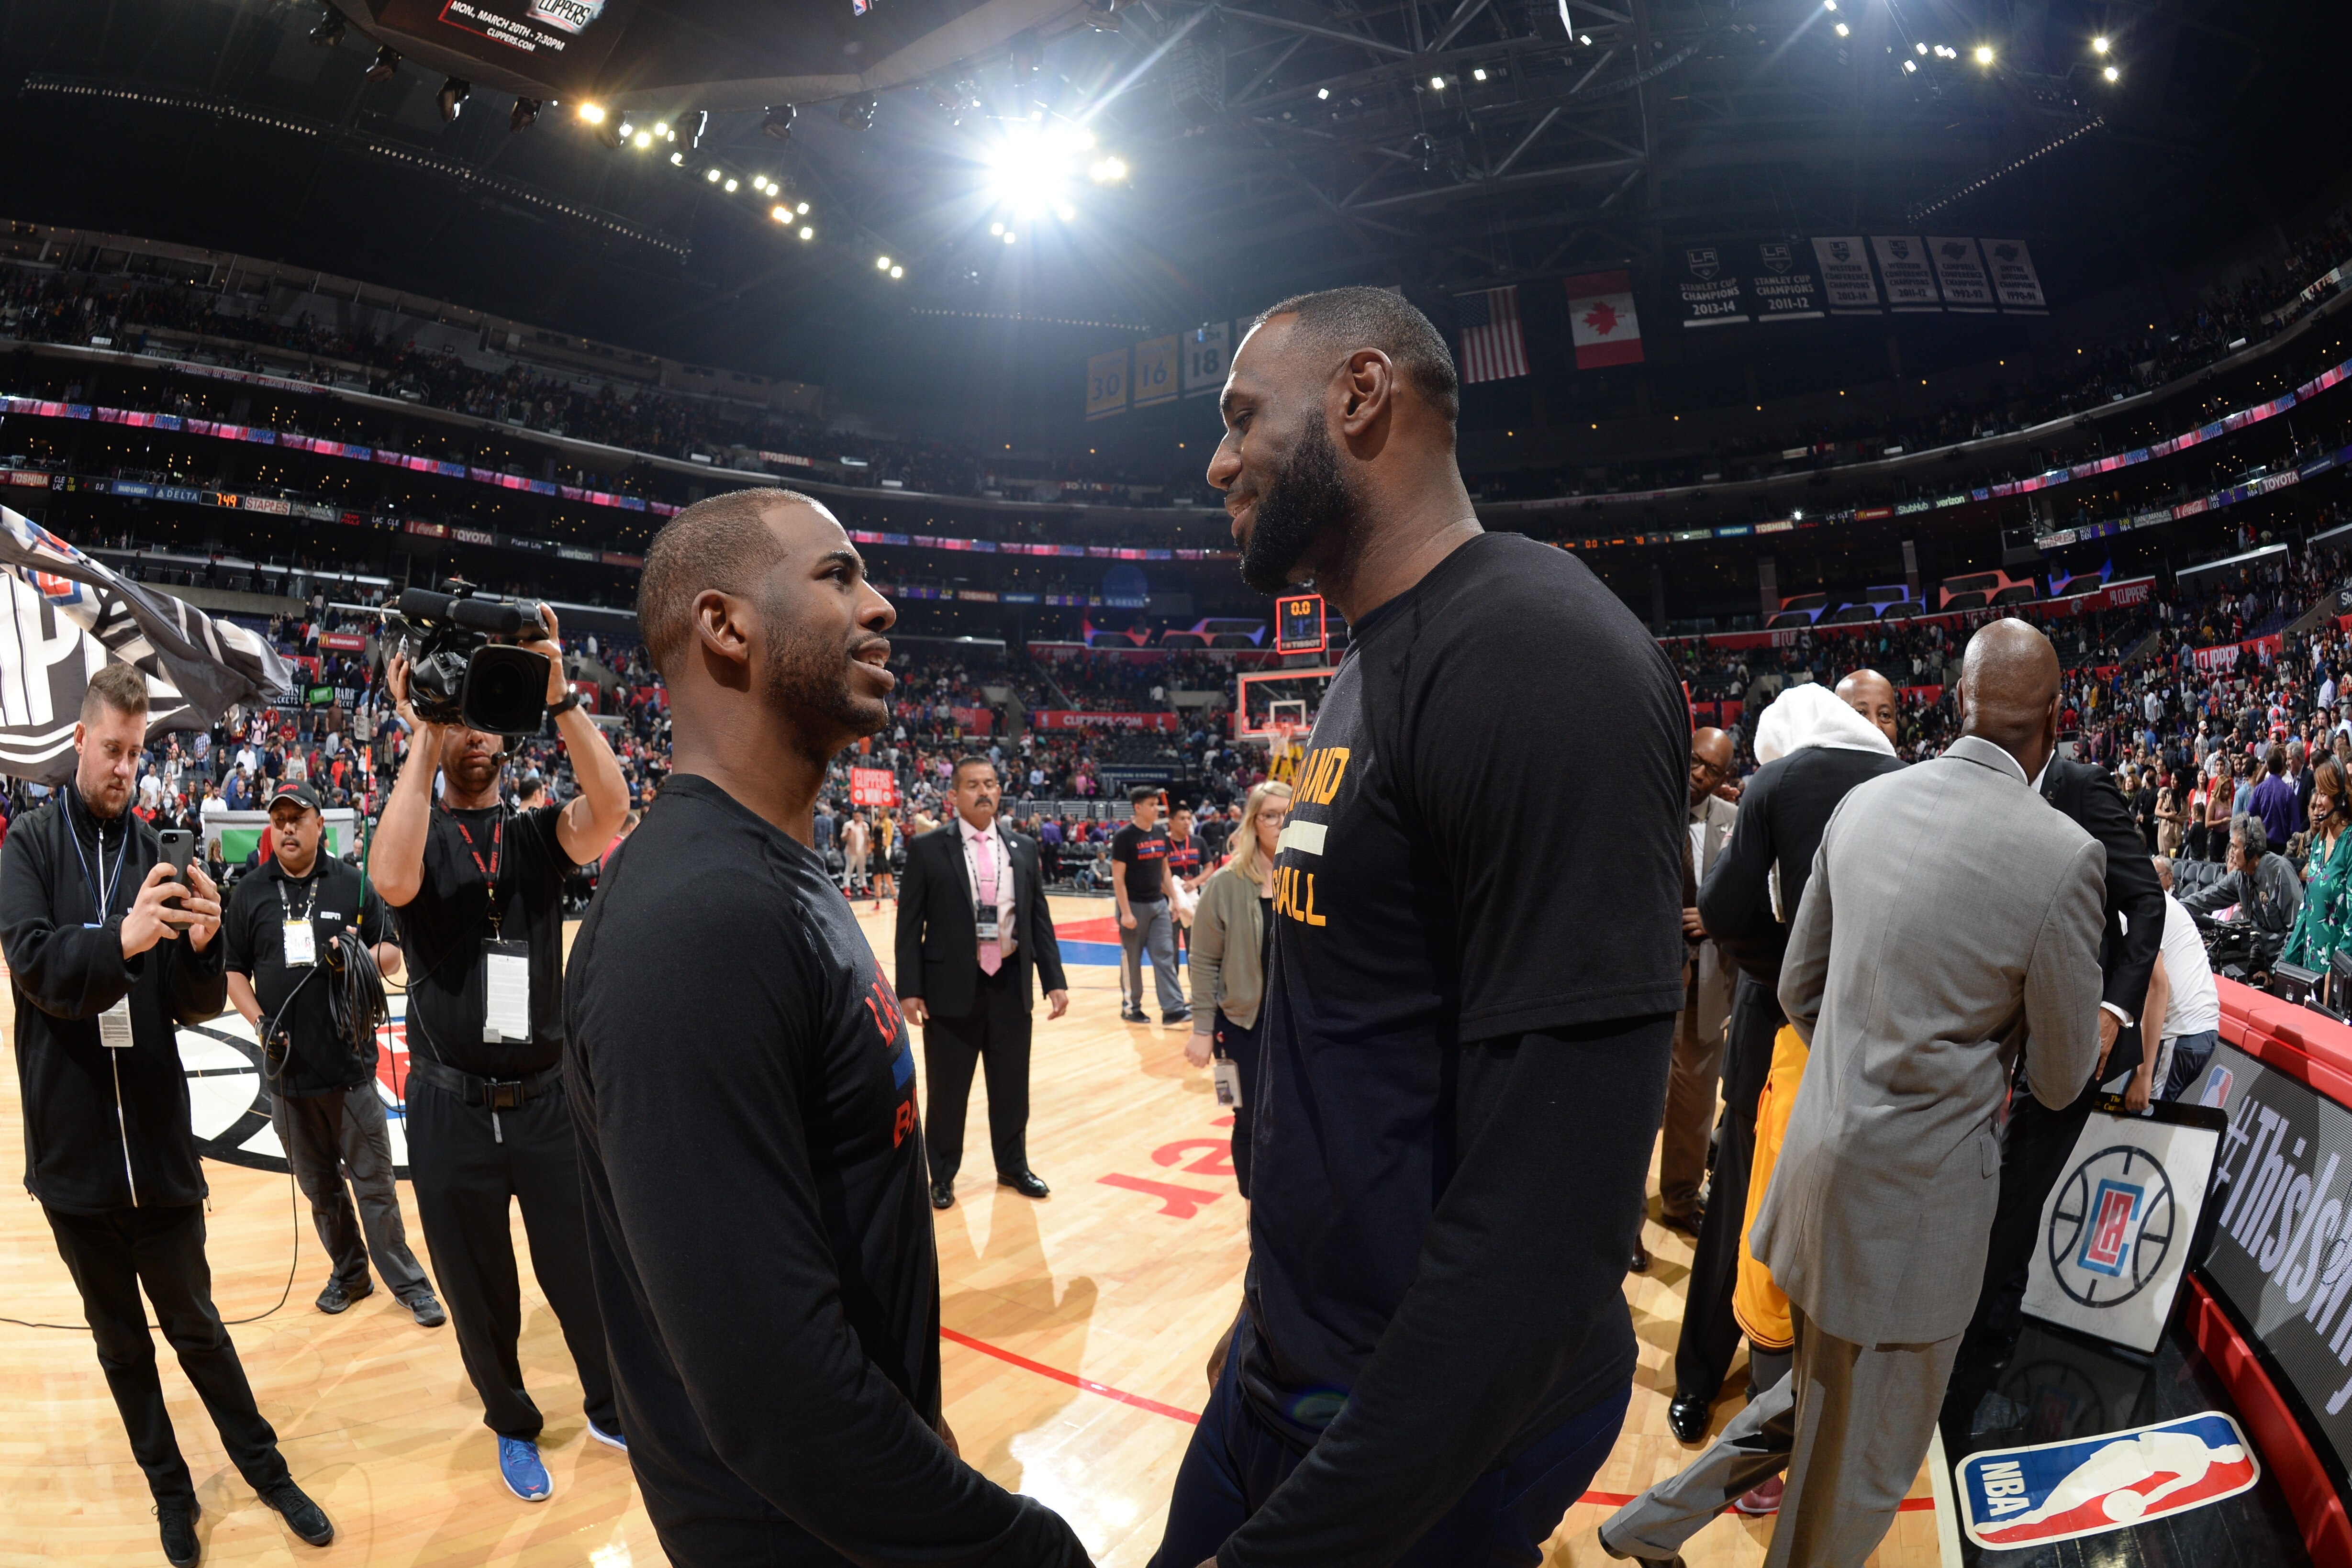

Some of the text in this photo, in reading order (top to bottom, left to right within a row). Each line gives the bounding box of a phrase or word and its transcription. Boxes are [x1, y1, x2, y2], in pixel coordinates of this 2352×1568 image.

[538, 0, 590, 25] CLIPPERS
[478, 10, 509, 29] MARCH
[508, 22, 531, 38] 20TH
[535, 32, 566, 51] 7:30PM
[487, 27, 535, 52] CLIPPERS.COM
[1691, 252, 1715, 263] LA
[1763, 247, 1788, 257] LA
[1754, 275, 1811, 285] STANLEY CUP
[1825, 272, 1869, 280] CONFERENCE
[1885, 270, 1928, 278] CONFERENCE
[1940, 270, 1984, 278] CONFERENCE
[1680, 278, 1737, 291] STANLEY CUP
[1830, 280, 1870, 289] CHAMPIONS
[1890, 278, 1929, 287] CHAMPIONS
[1945, 279, 1984, 287] CHAMPIONS
[2001, 281, 2036, 289] CHAMPIONS
[1682, 286, 1740, 301] CHAMPIONS
[1756, 284, 1815, 296] CHAMPIONS
[1838, 291, 1867, 301] 2013-14
[1898, 288, 1928, 298] 2011-12
[1952, 289, 1983, 298] 1992-93
[2007, 291, 2037, 300] 1990-91
[1693, 300, 1736, 315] 2013-14
[1768, 297, 1809, 310] 2011-12
[1192, 348, 1220, 378] 18
[1142, 359, 1168, 387] 16
[291, 383, 312, 393] 69050
[1092, 373, 1120, 401] 30
[765, 452, 809, 467] TOSHIBA
[11, 473, 48, 485] TOSHIBA
[54, 475, 66, 483] CLE
[2263, 470, 2298, 491] TOYOTA
[131, 486, 148, 494] LIGHT
[167, 490, 198, 502] DELTA
[2247, 489, 2258, 498] NBA
[246, 499, 289, 514] STAPLES
[292, 503, 306, 512] SAN
[1936, 494, 1965, 509] verizon
[1897, 501, 1929, 515] StubHub
[2182, 501, 2202, 516] Coca-Cola
[372, 516, 400, 527] LAC CLE
[2134, 515, 2146, 523] SAN
[2148, 510, 2171, 522] MANUEL
[1755, 521, 1794, 534] TOSHIBA
[451, 528, 493, 545] TOYOTA
[2040, 533, 2075, 547] STAPLES
[2081, 532, 2092, 540] DEN
[560, 550, 593, 561] verizon
[2118, 584, 2149, 604] CLIPPERS
[1115, 599, 1145, 608] DELTA
[1291, 601, 1311, 616] 0.0
[329, 637, 359, 646] McDonald's
[1063, 713, 1143, 727] CLIPPERS.COM
[854, 769, 891, 790] CLIPPERS
[2111, 1095, 2121, 1103] The
[1980, 1460, 2026, 1517] NBA
